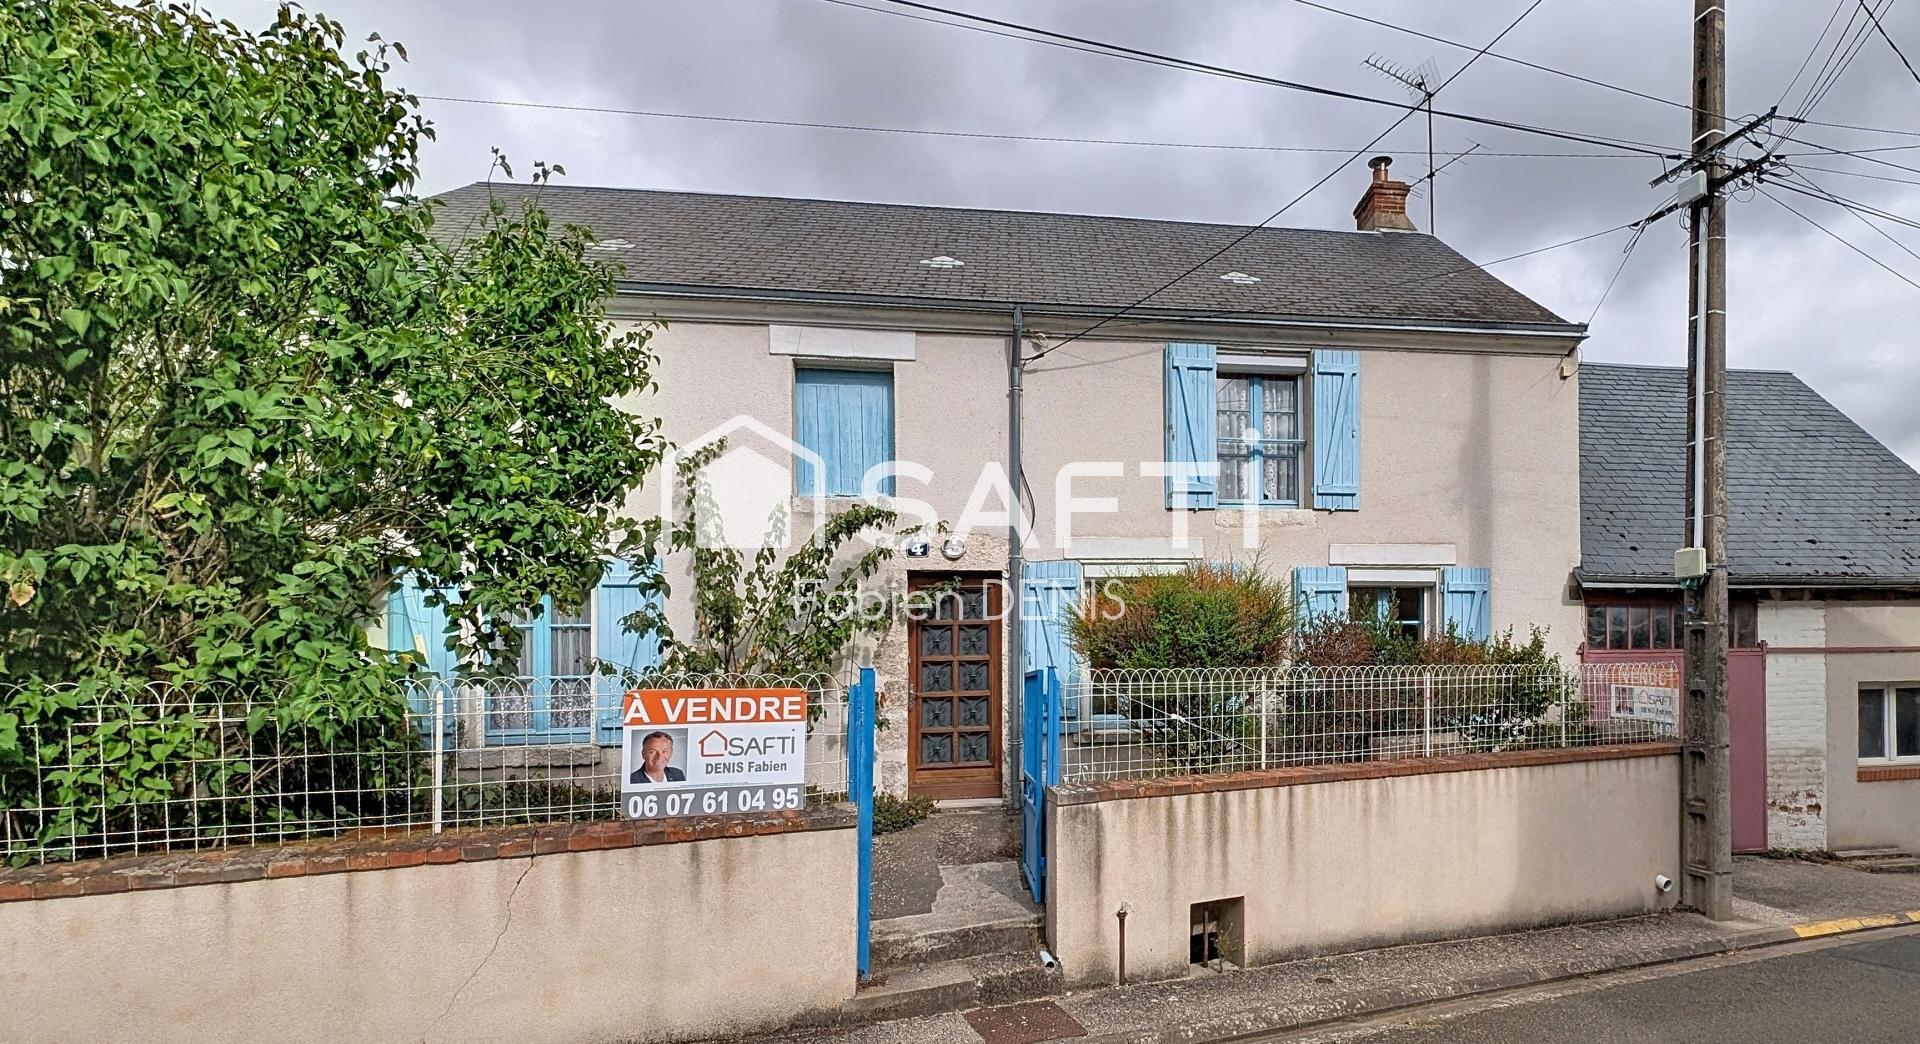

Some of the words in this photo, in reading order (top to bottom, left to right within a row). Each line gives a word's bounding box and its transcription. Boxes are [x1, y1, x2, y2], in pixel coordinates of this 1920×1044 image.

[910, 543, 924, 556] 4
[623, 693, 650, 724] À
[661, 696, 801, 722] VENDRE
[705, 762, 744, 775] DENIS
[747, 760, 787, 773] Fabien
[628, 795, 658, 818] 06
[666, 793, 695, 816] 07
[702, 791, 729, 814] 61
[738, 790, 766, 811] 04
[772, 787, 799, 810] 95
